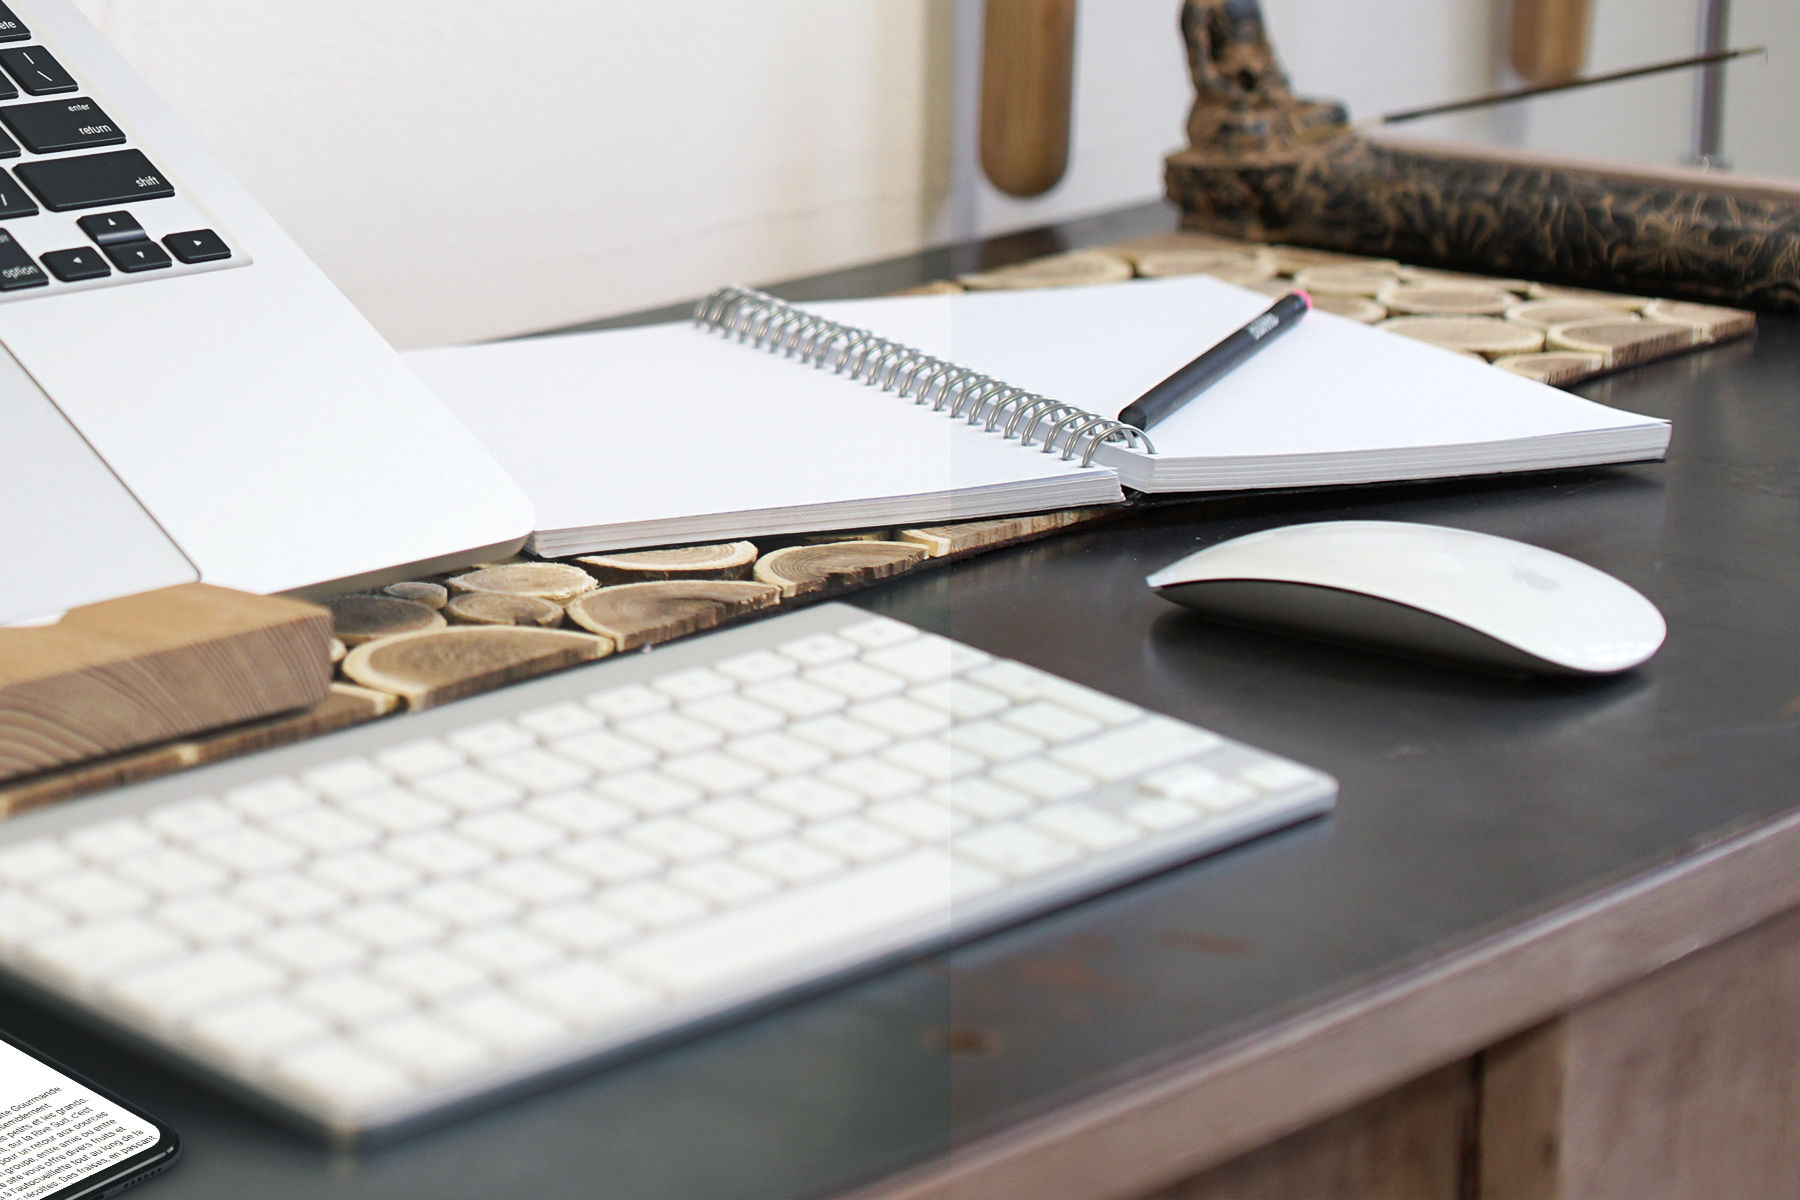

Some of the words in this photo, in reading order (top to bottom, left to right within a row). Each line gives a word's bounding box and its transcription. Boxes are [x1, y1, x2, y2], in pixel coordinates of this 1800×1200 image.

[68, 103, 90, 113] enter
[79, 125, 111, 134] return
[136, 176, 159, 187] shift
[3, 264, 39, 278] option
